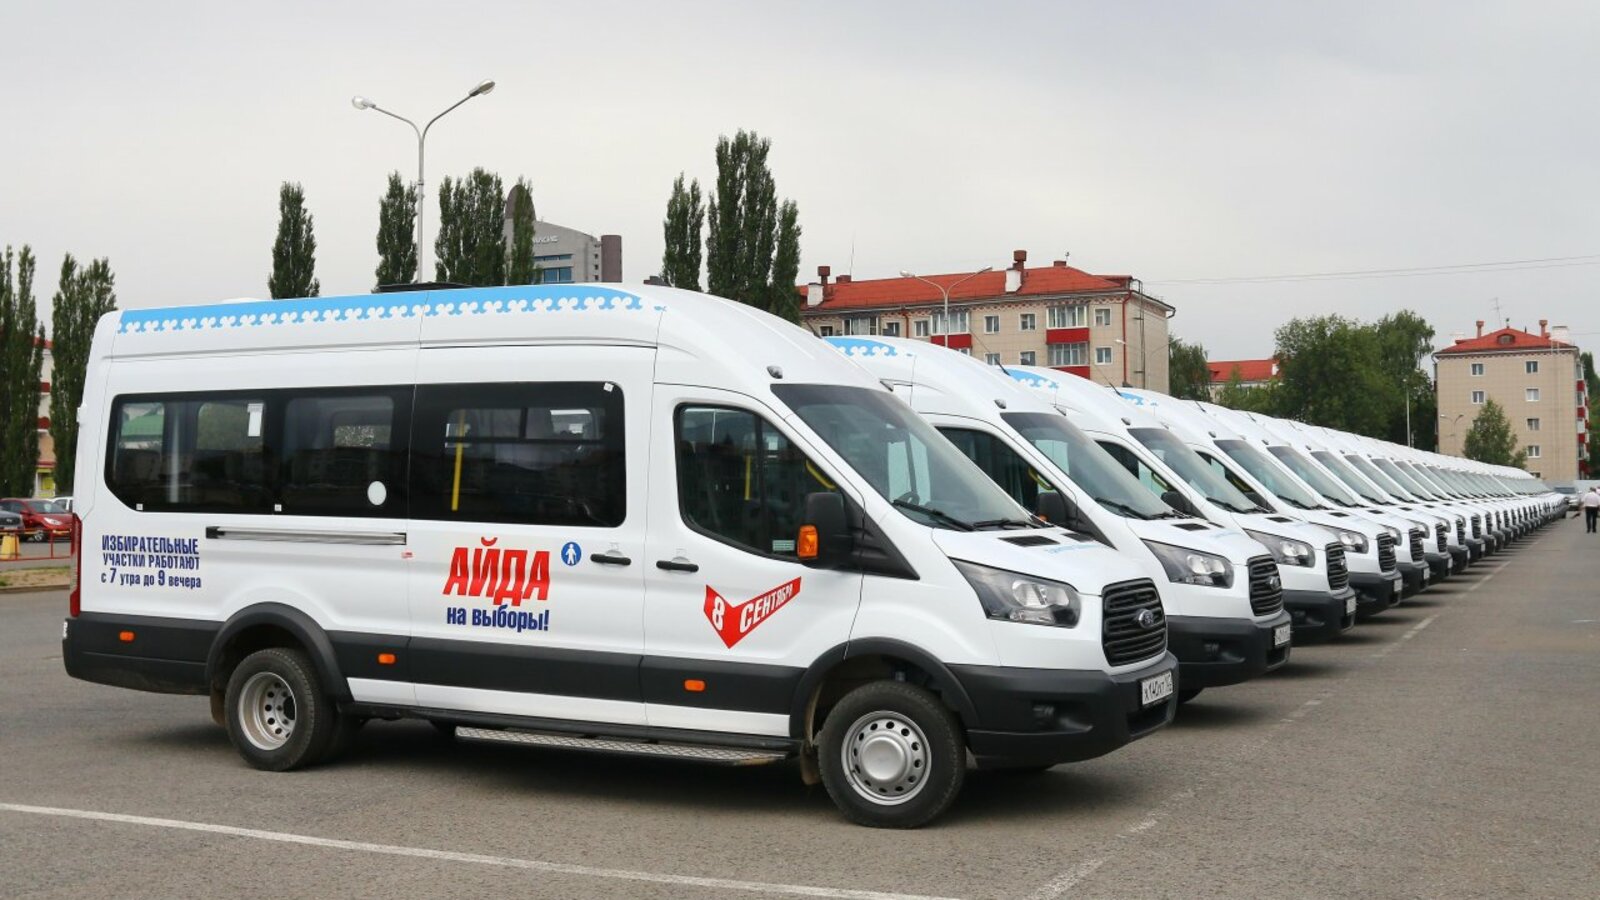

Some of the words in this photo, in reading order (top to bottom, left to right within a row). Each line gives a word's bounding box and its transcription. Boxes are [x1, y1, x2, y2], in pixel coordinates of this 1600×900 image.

[101, 534, 199, 555] ИЗБИРАТЕЛЬНЫЕ
[103, 552, 146, 568] УЧАСТКИ
[148, 554, 200, 570] РАБОТАЮТ
[443, 536, 551, 607] АЙДА
[100, 572, 107, 583] с
[109, 567, 117, 583] 7
[120, 573, 141, 586] утра
[143, 574, 155, 587] до
[158, 569, 165, 586] 9
[168, 575, 202, 589] вечера
[446, 606, 467, 626] на
[471, 603, 550, 633] выборы!
[711, 595, 726, 631] 8
[739, 582, 794, 634] СЕНТЯБРЯ
